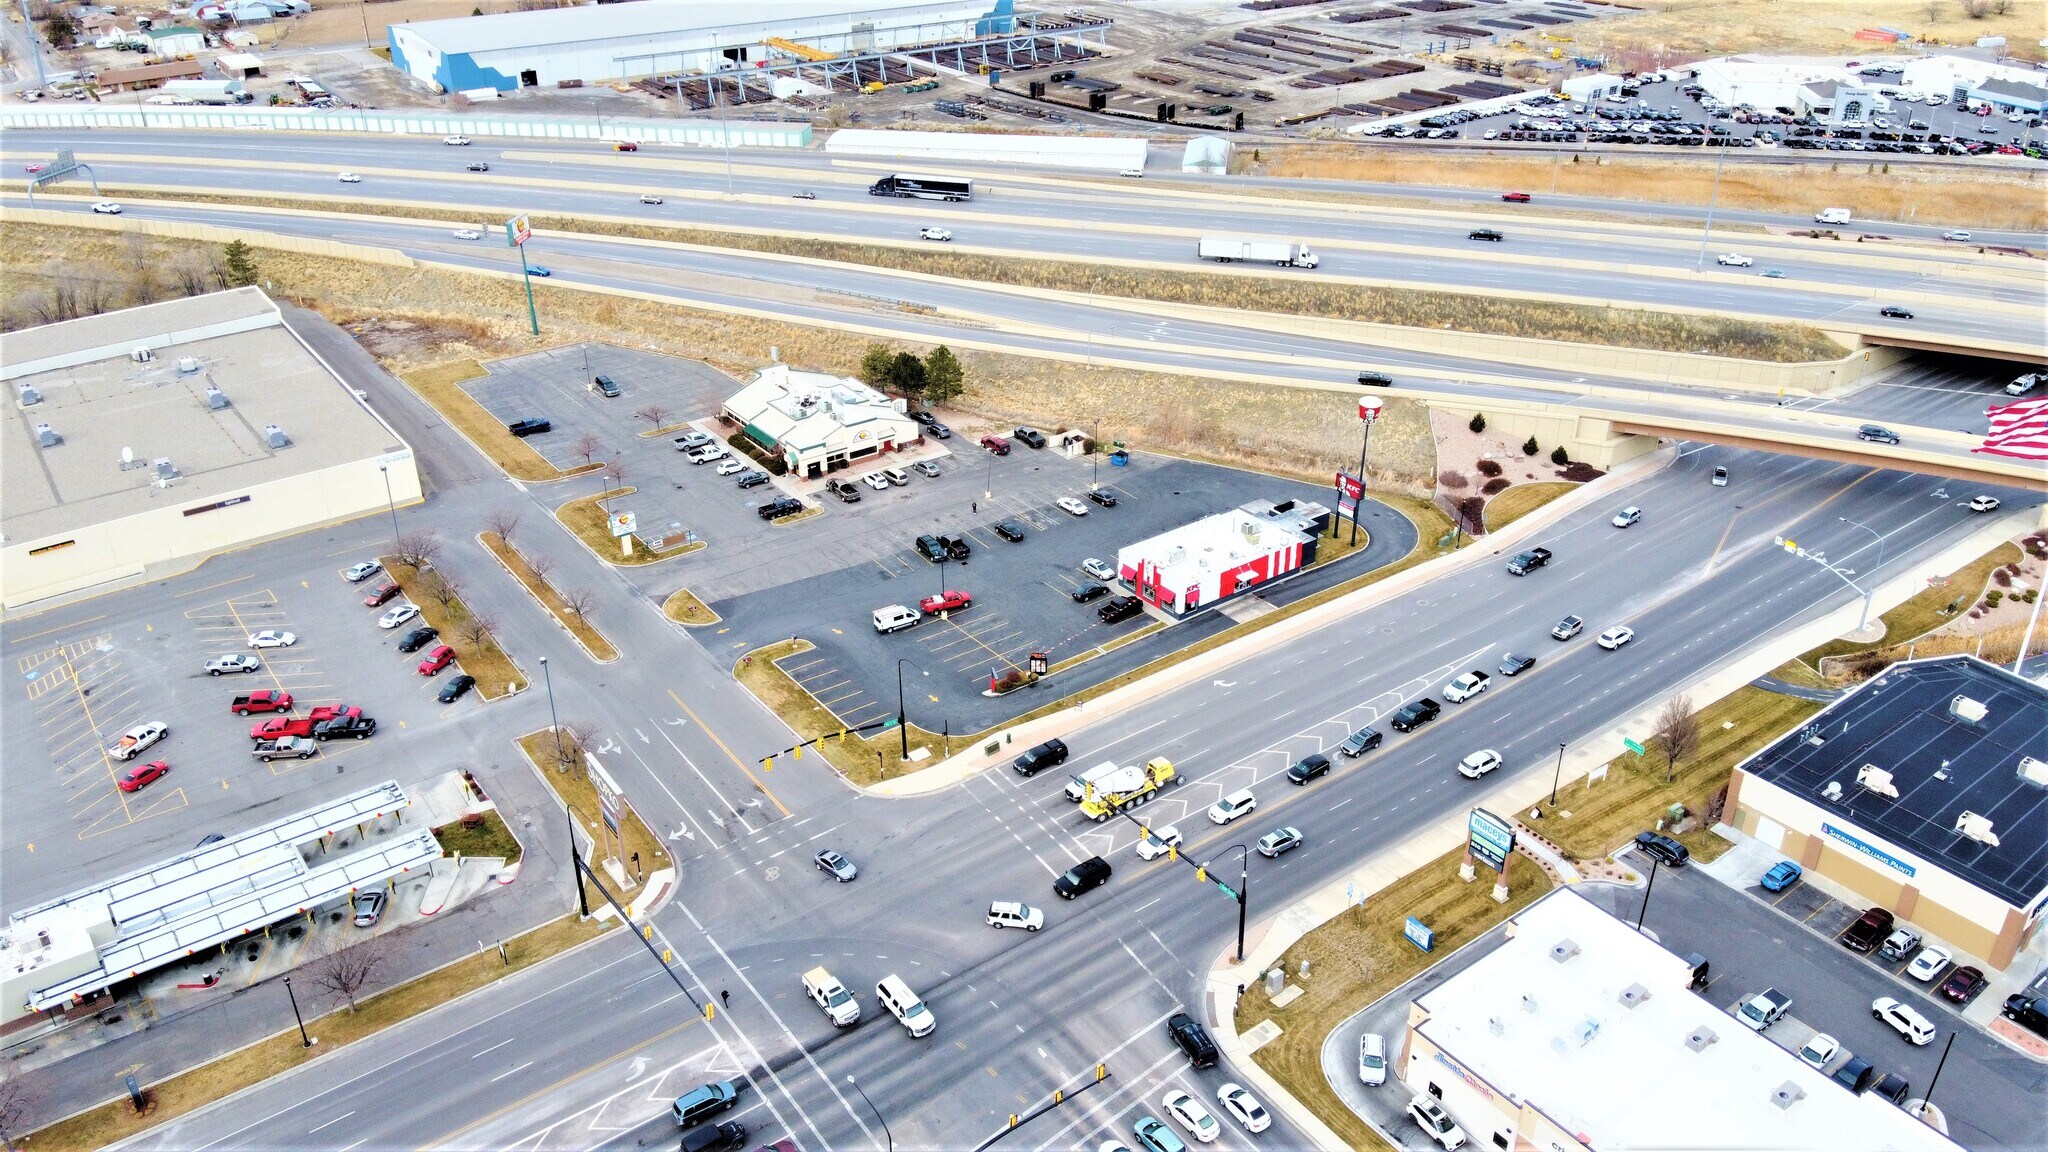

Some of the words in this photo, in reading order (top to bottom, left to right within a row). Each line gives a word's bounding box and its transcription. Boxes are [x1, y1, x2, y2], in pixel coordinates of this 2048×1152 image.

[1346, 484, 1360, 493] KFC
[1186, 582, 1200, 593] KFC
[1890, 860, 1912, 876] PAINTS
